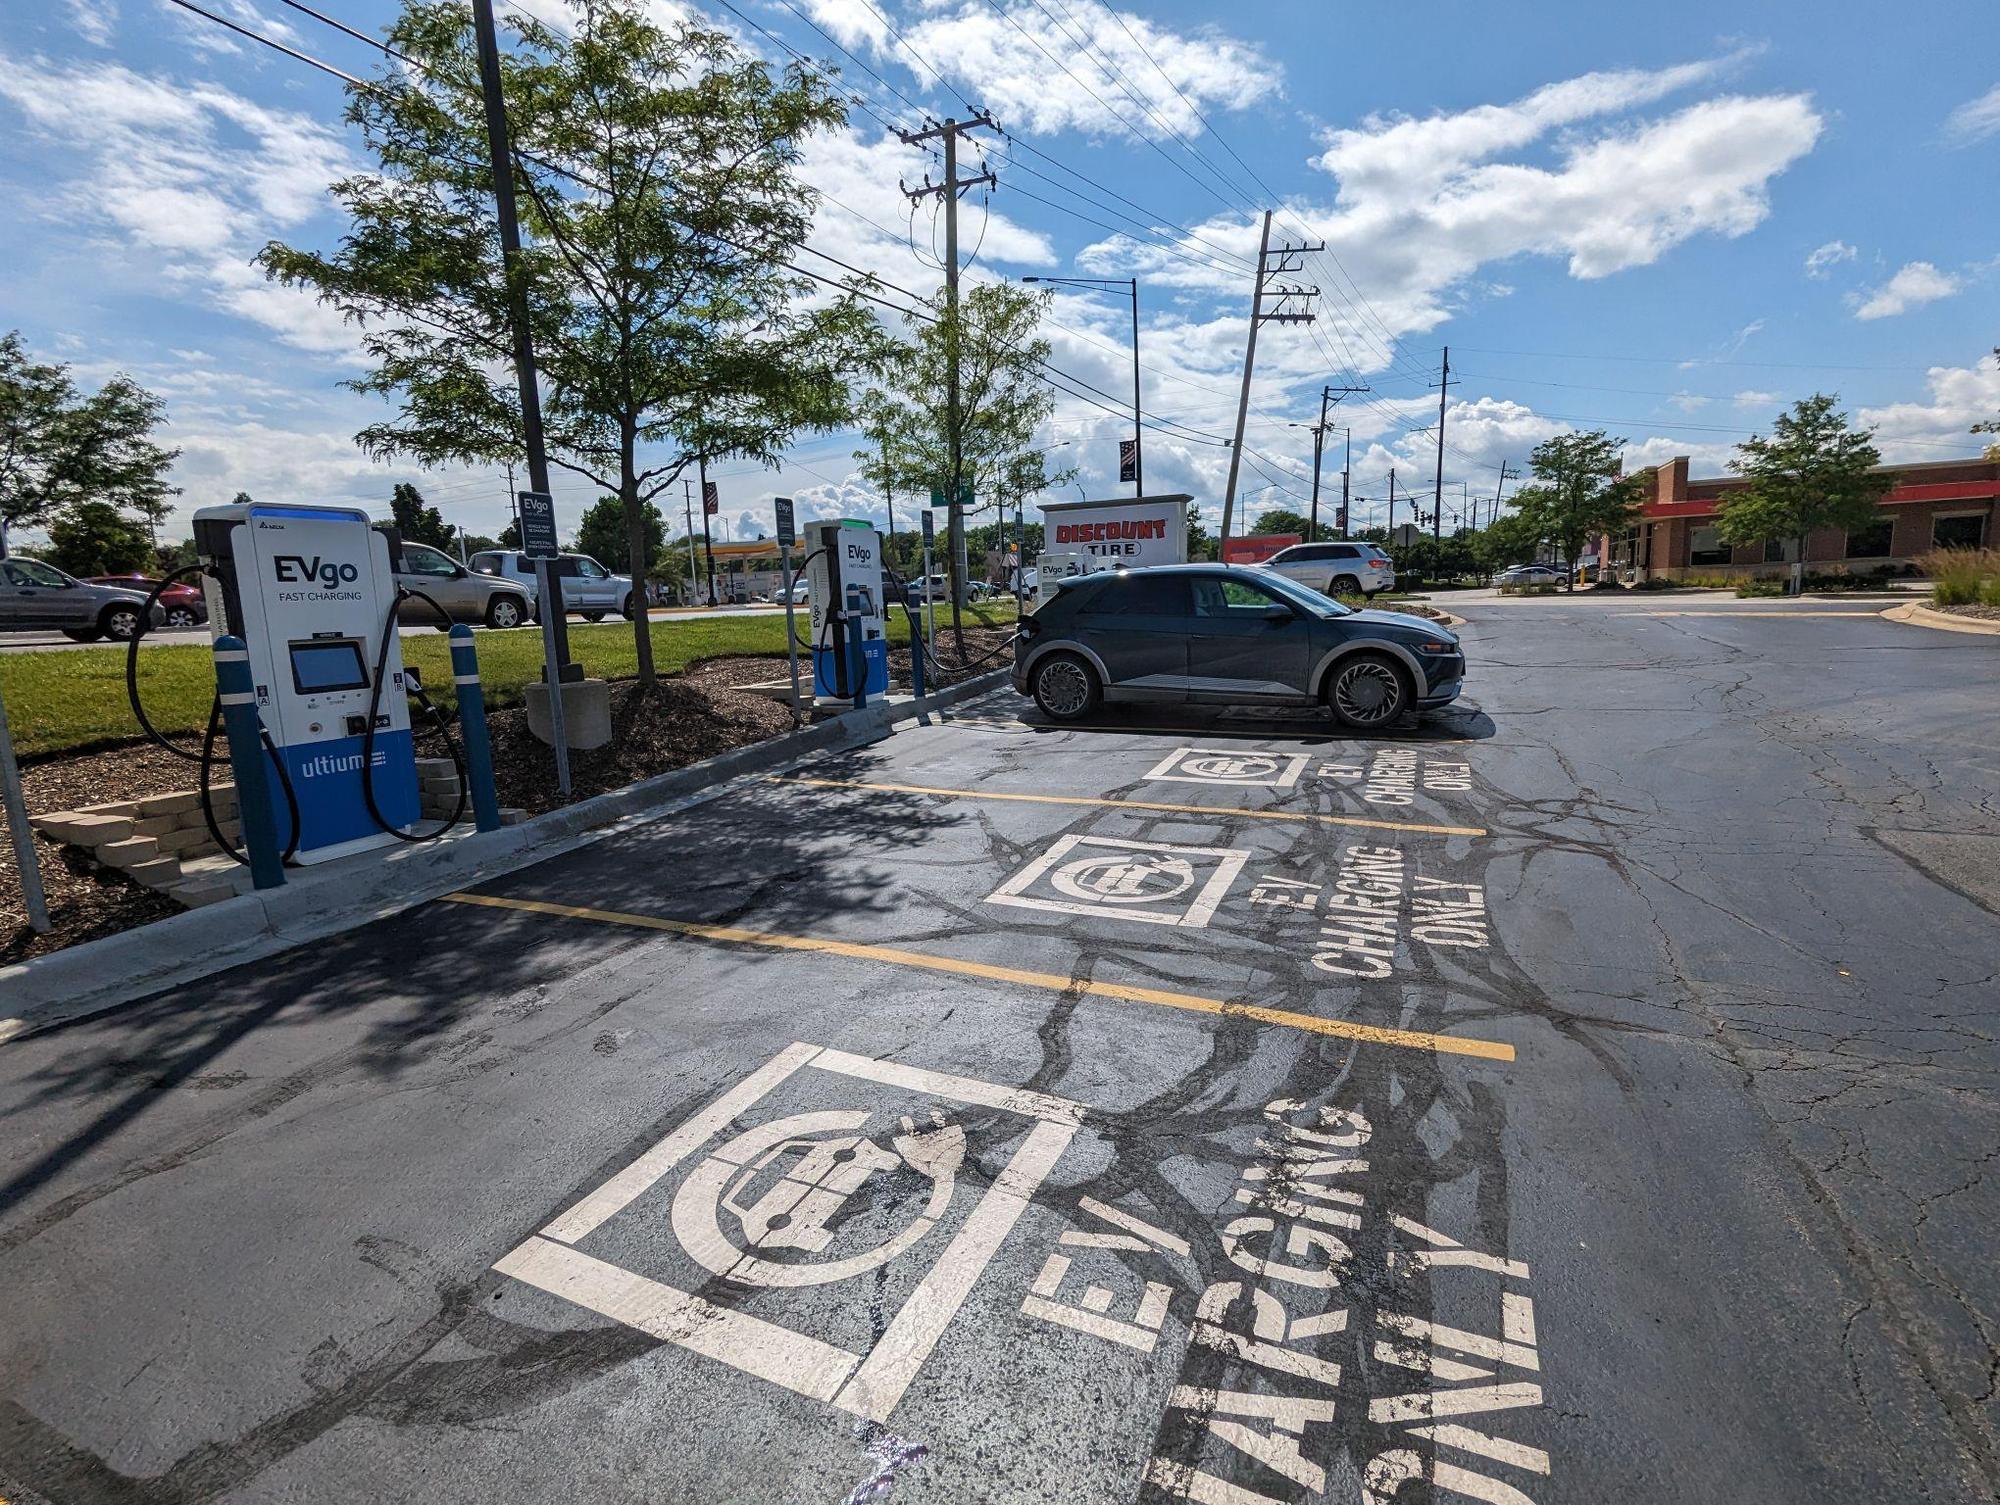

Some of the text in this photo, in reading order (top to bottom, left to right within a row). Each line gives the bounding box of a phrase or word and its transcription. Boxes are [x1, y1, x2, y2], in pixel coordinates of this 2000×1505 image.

[524, 498, 548, 514] EVgo
[1056, 519, 1166, 543] DISCOUNT
[848, 545, 871, 562] EVgo
[1087, 543, 1135, 556] TIRE
[273, 555, 359, 590] EVgo
[1043, 566, 1062, 575] EVgo
[279, 592, 362, 601] FAST CHARGING
[813, 604, 821, 628] EVgo
[302, 754, 365, 778] ultium
[1317, 763, 1364, 779] EV
[1364, 749, 1418, 805] CHARGING
[1423, 760, 1473, 791] ONLY
[1248, 874, 1323, 910] EV
[1311, 846, 1404, 979] CHARGING
[1410, 875, 1490, 948] ONLY
[1021, 1195, 1191, 1353] EV
[1141, 1098, 1373, 1505] ARGING
